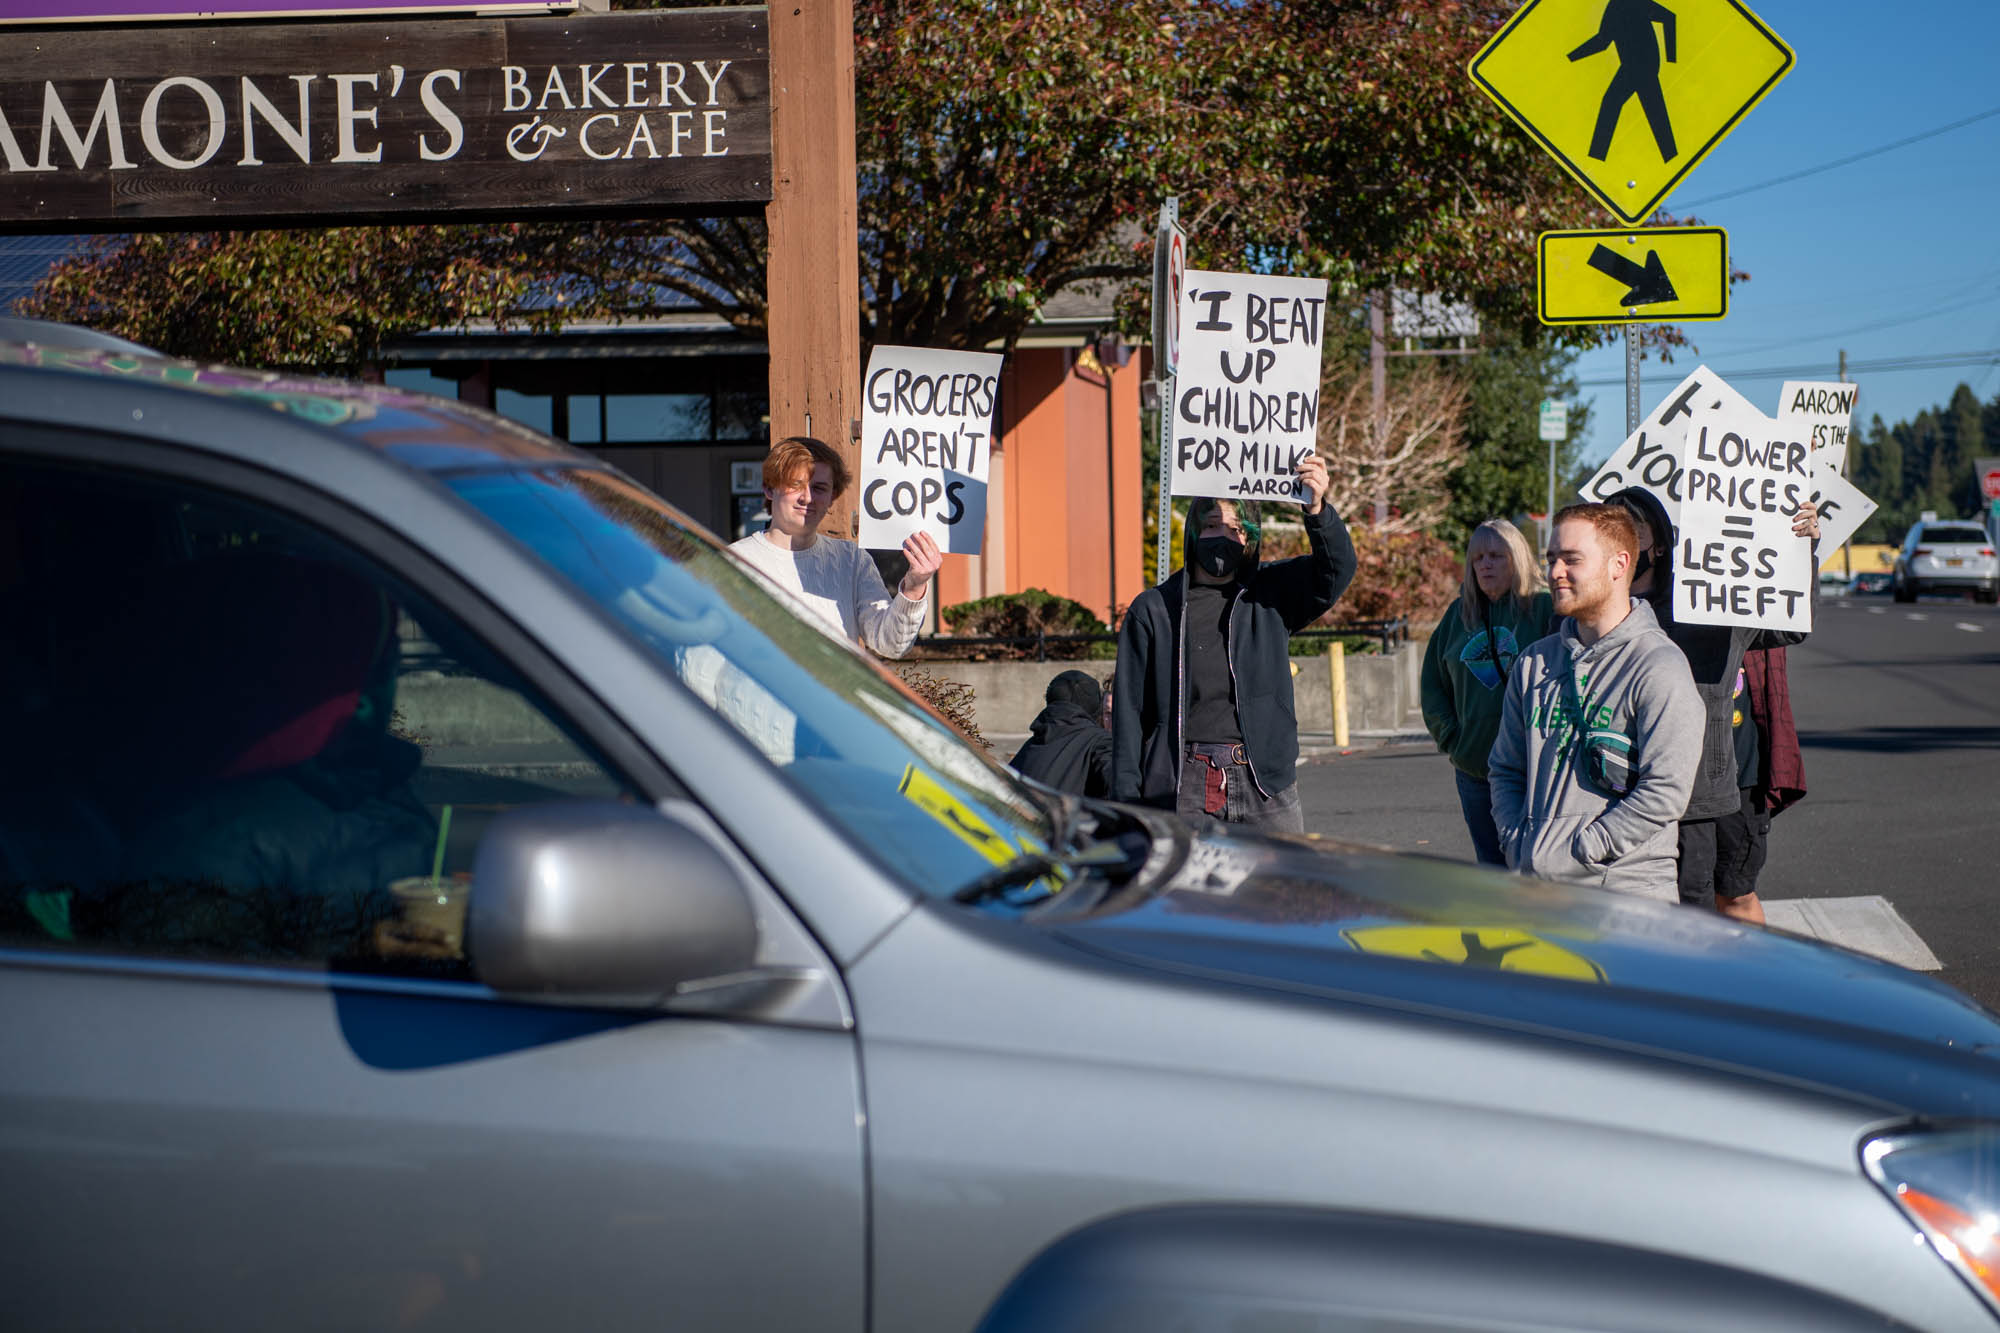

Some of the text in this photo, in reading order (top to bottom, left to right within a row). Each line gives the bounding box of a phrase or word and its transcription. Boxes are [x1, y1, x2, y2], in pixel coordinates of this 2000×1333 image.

[502, 60, 732, 112] BAKERY
[505, 110, 730, 162] & CAFE
[1246, 292, 1325, 347] BEAT
[1220, 348, 1276, 384] UP
[867, 367, 997, 419] GROCERS
[1179, 386, 1319, 434] CHILDREN
[1791, 387, 1853, 416] AARON
[876, 421, 985, 474] AREN'T
[1178, 436, 1232, 474] FOR
[1697, 426, 1807, 477] LOWER
[1830, 424, 1848, 447] THE
[863, 477, 965, 526] COPS
[1688, 468, 1801, 517] PRICES
[1721, 515, 1755, 540] =
[1683, 537, 1779, 579] LESS
[1682, 578, 1805, 619] THEFT
